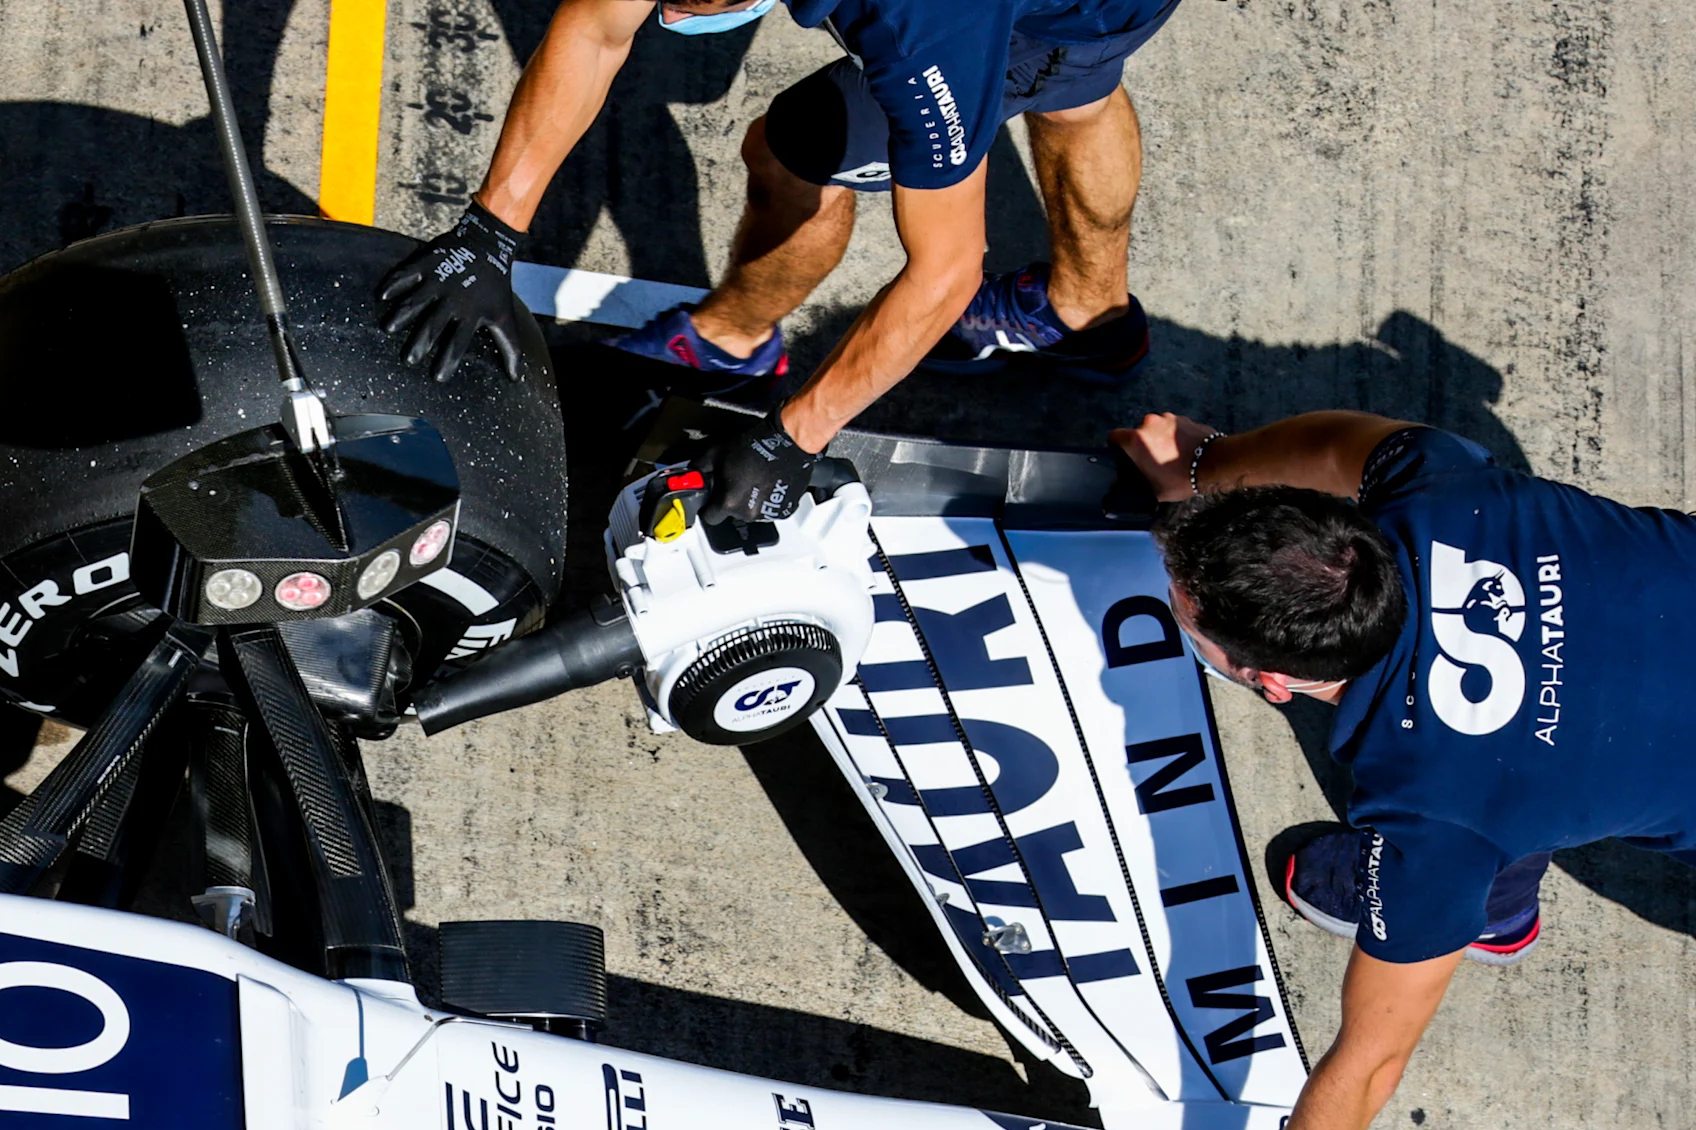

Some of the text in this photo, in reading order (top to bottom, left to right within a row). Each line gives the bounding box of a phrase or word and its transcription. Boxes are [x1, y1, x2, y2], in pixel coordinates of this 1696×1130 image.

[907, 77, 944, 168] SCUDERIA
[1533, 554, 1566, 747] ALPHATAURI
[834, 543, 1142, 998] TAURI
[1101, 594, 1286, 1066] MIND
[1366, 833, 1385, 918] ALPHATAU
